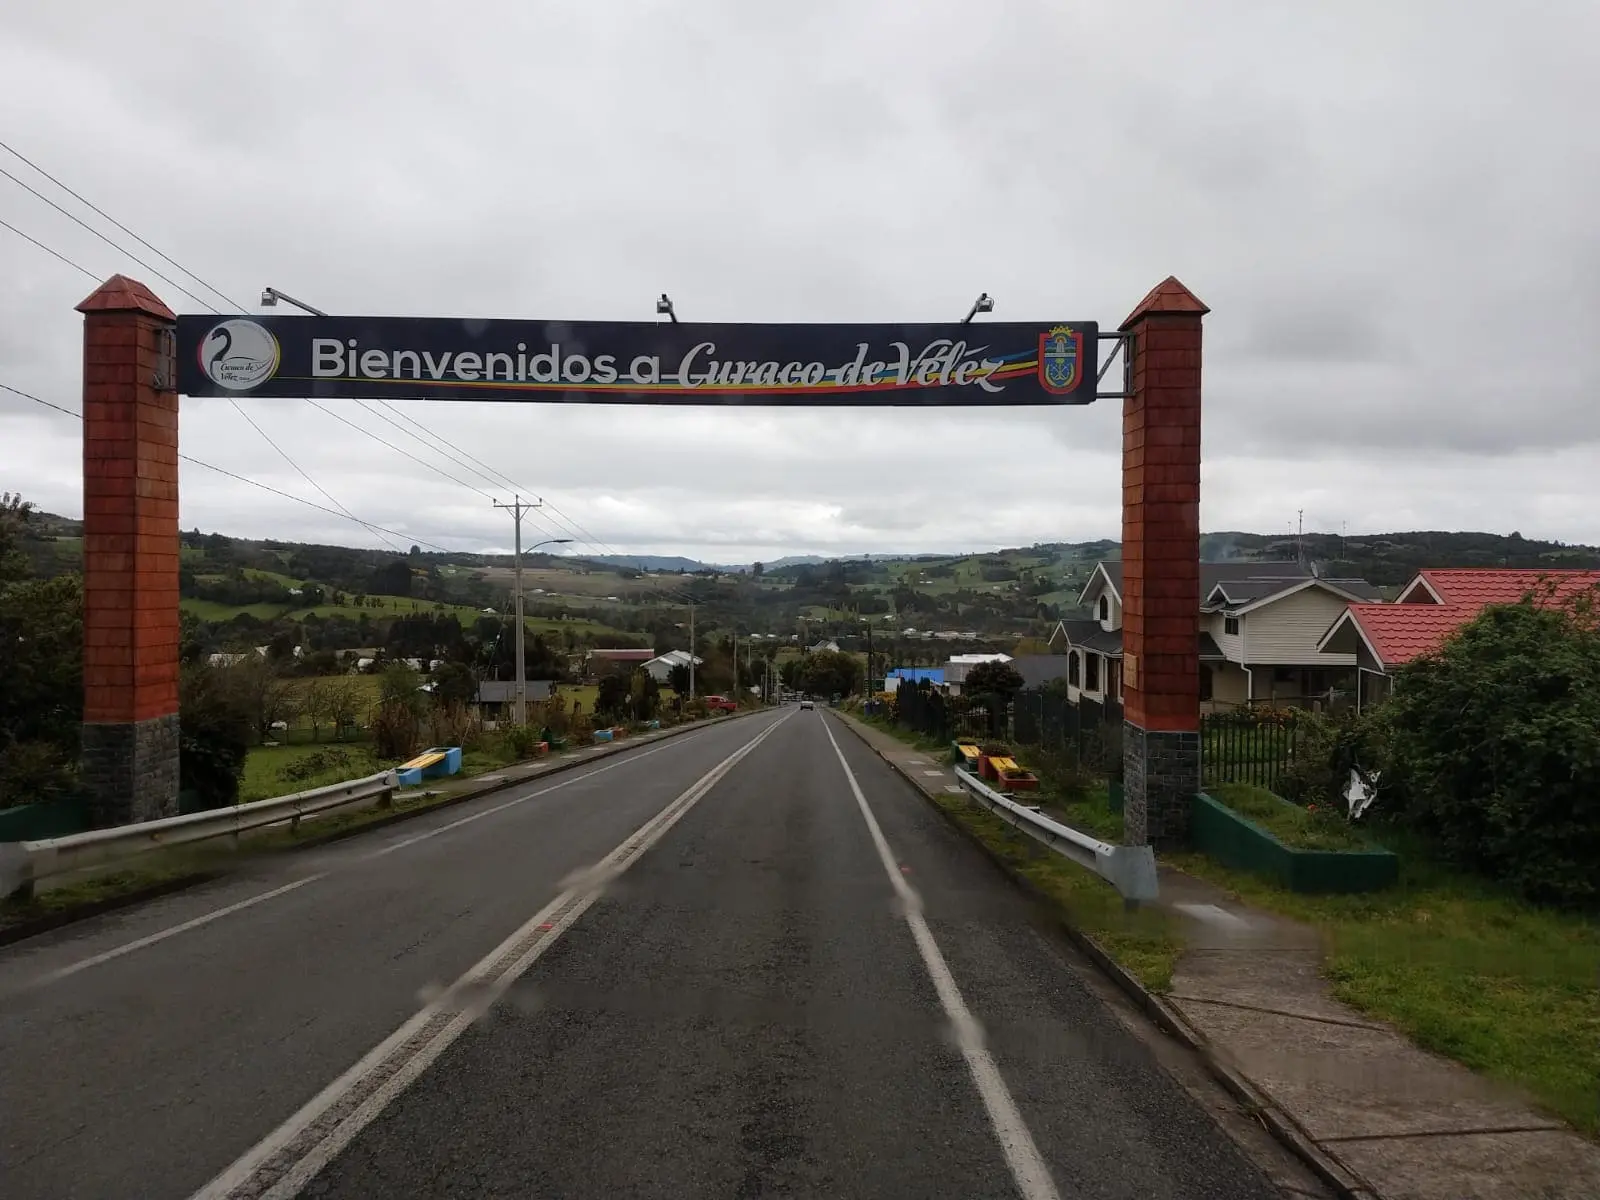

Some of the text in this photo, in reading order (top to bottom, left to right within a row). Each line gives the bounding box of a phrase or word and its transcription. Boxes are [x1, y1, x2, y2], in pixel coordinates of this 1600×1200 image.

[312, 338, 1006, 393] Bienvenidos a Curaco de Vélez
